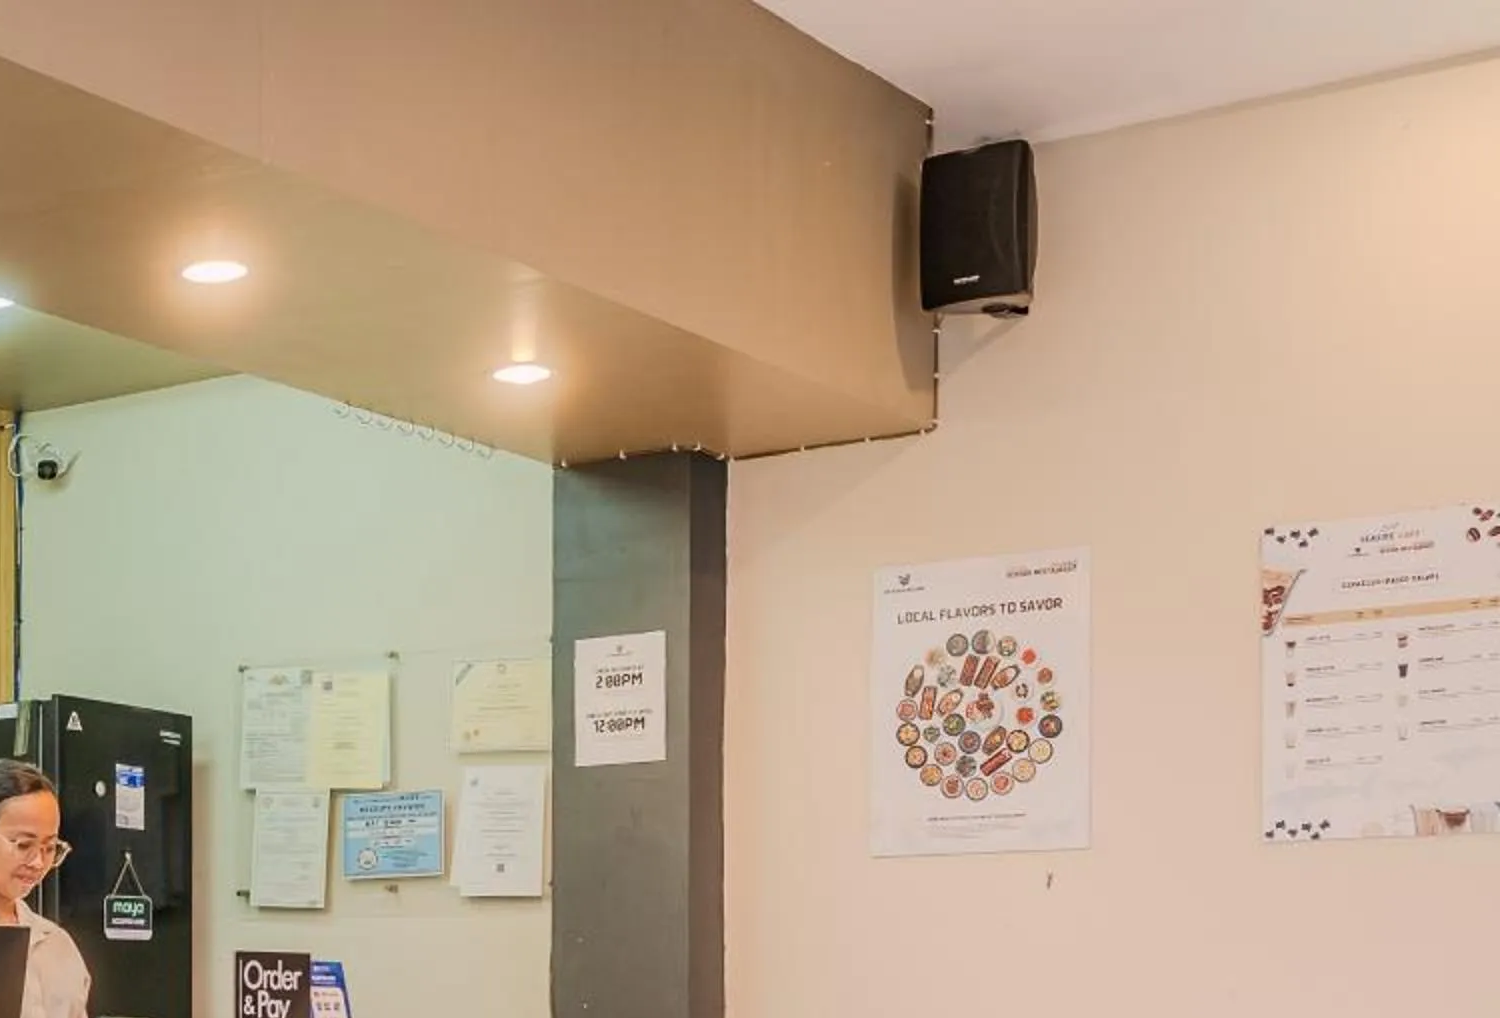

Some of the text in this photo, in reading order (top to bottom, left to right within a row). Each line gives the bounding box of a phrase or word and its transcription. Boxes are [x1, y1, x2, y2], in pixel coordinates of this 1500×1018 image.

[897, 597, 1064, 625] LOCAL FLAVORS TO SAVOR
[112, 901, 145, 917] maya
[243, 959, 303, 991] Order
[243, 995, 256, 1016] &
